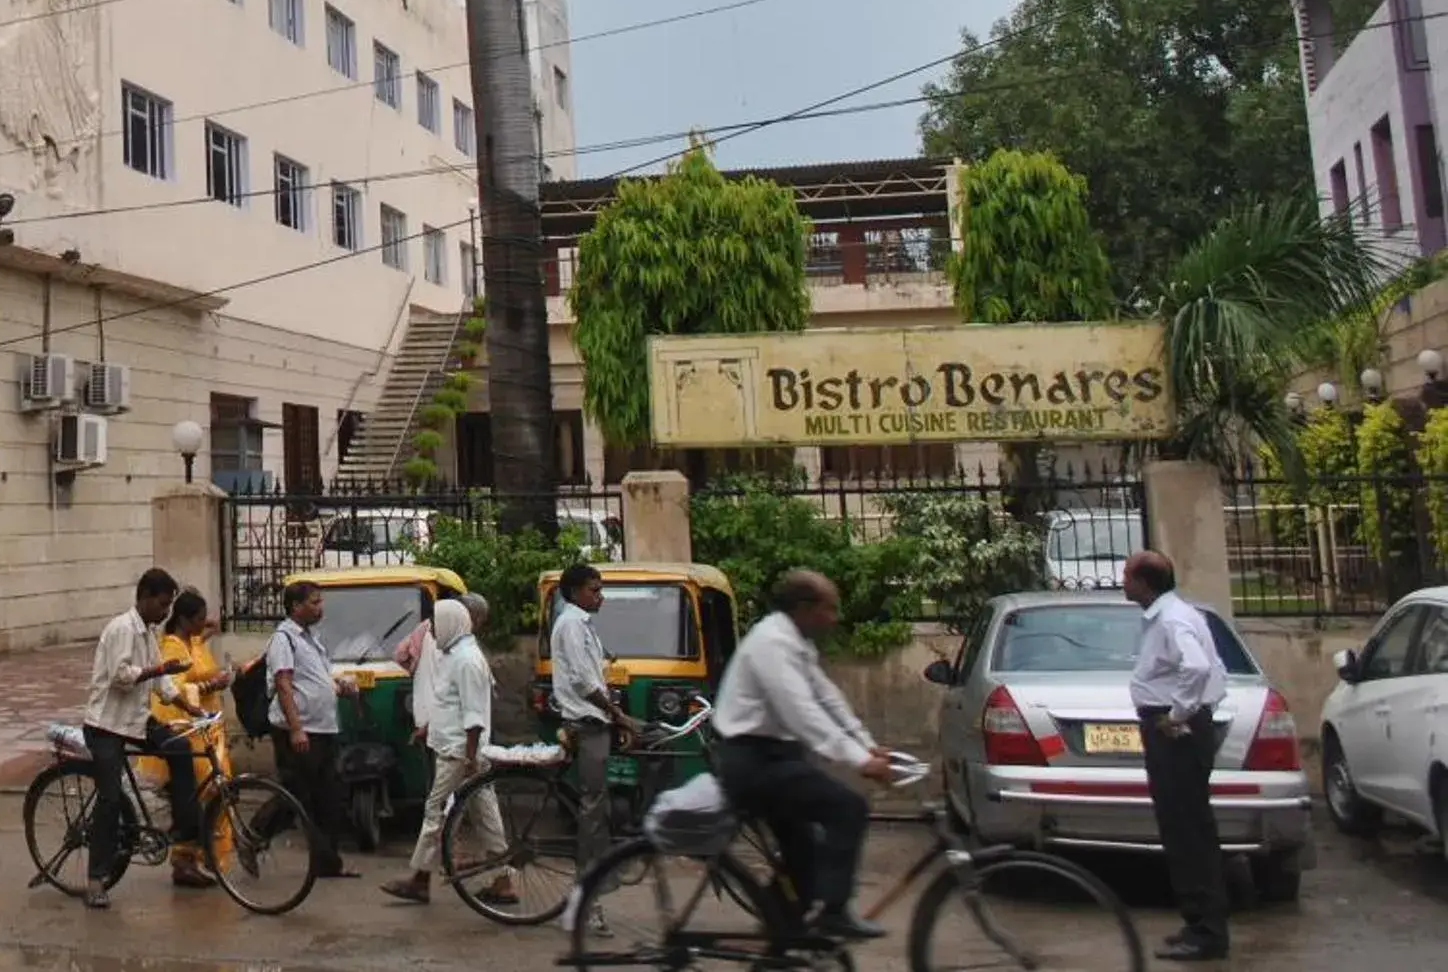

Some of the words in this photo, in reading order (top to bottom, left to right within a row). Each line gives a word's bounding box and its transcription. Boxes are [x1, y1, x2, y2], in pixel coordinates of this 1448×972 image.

[766, 368, 931, 411] Bistro
[936, 362, 1163, 408] Benares
[805, 414, 872, 437] MULTI
[878, 412, 957, 435] CUISINE
[966, 407, 1110, 434] RESTAURANT
